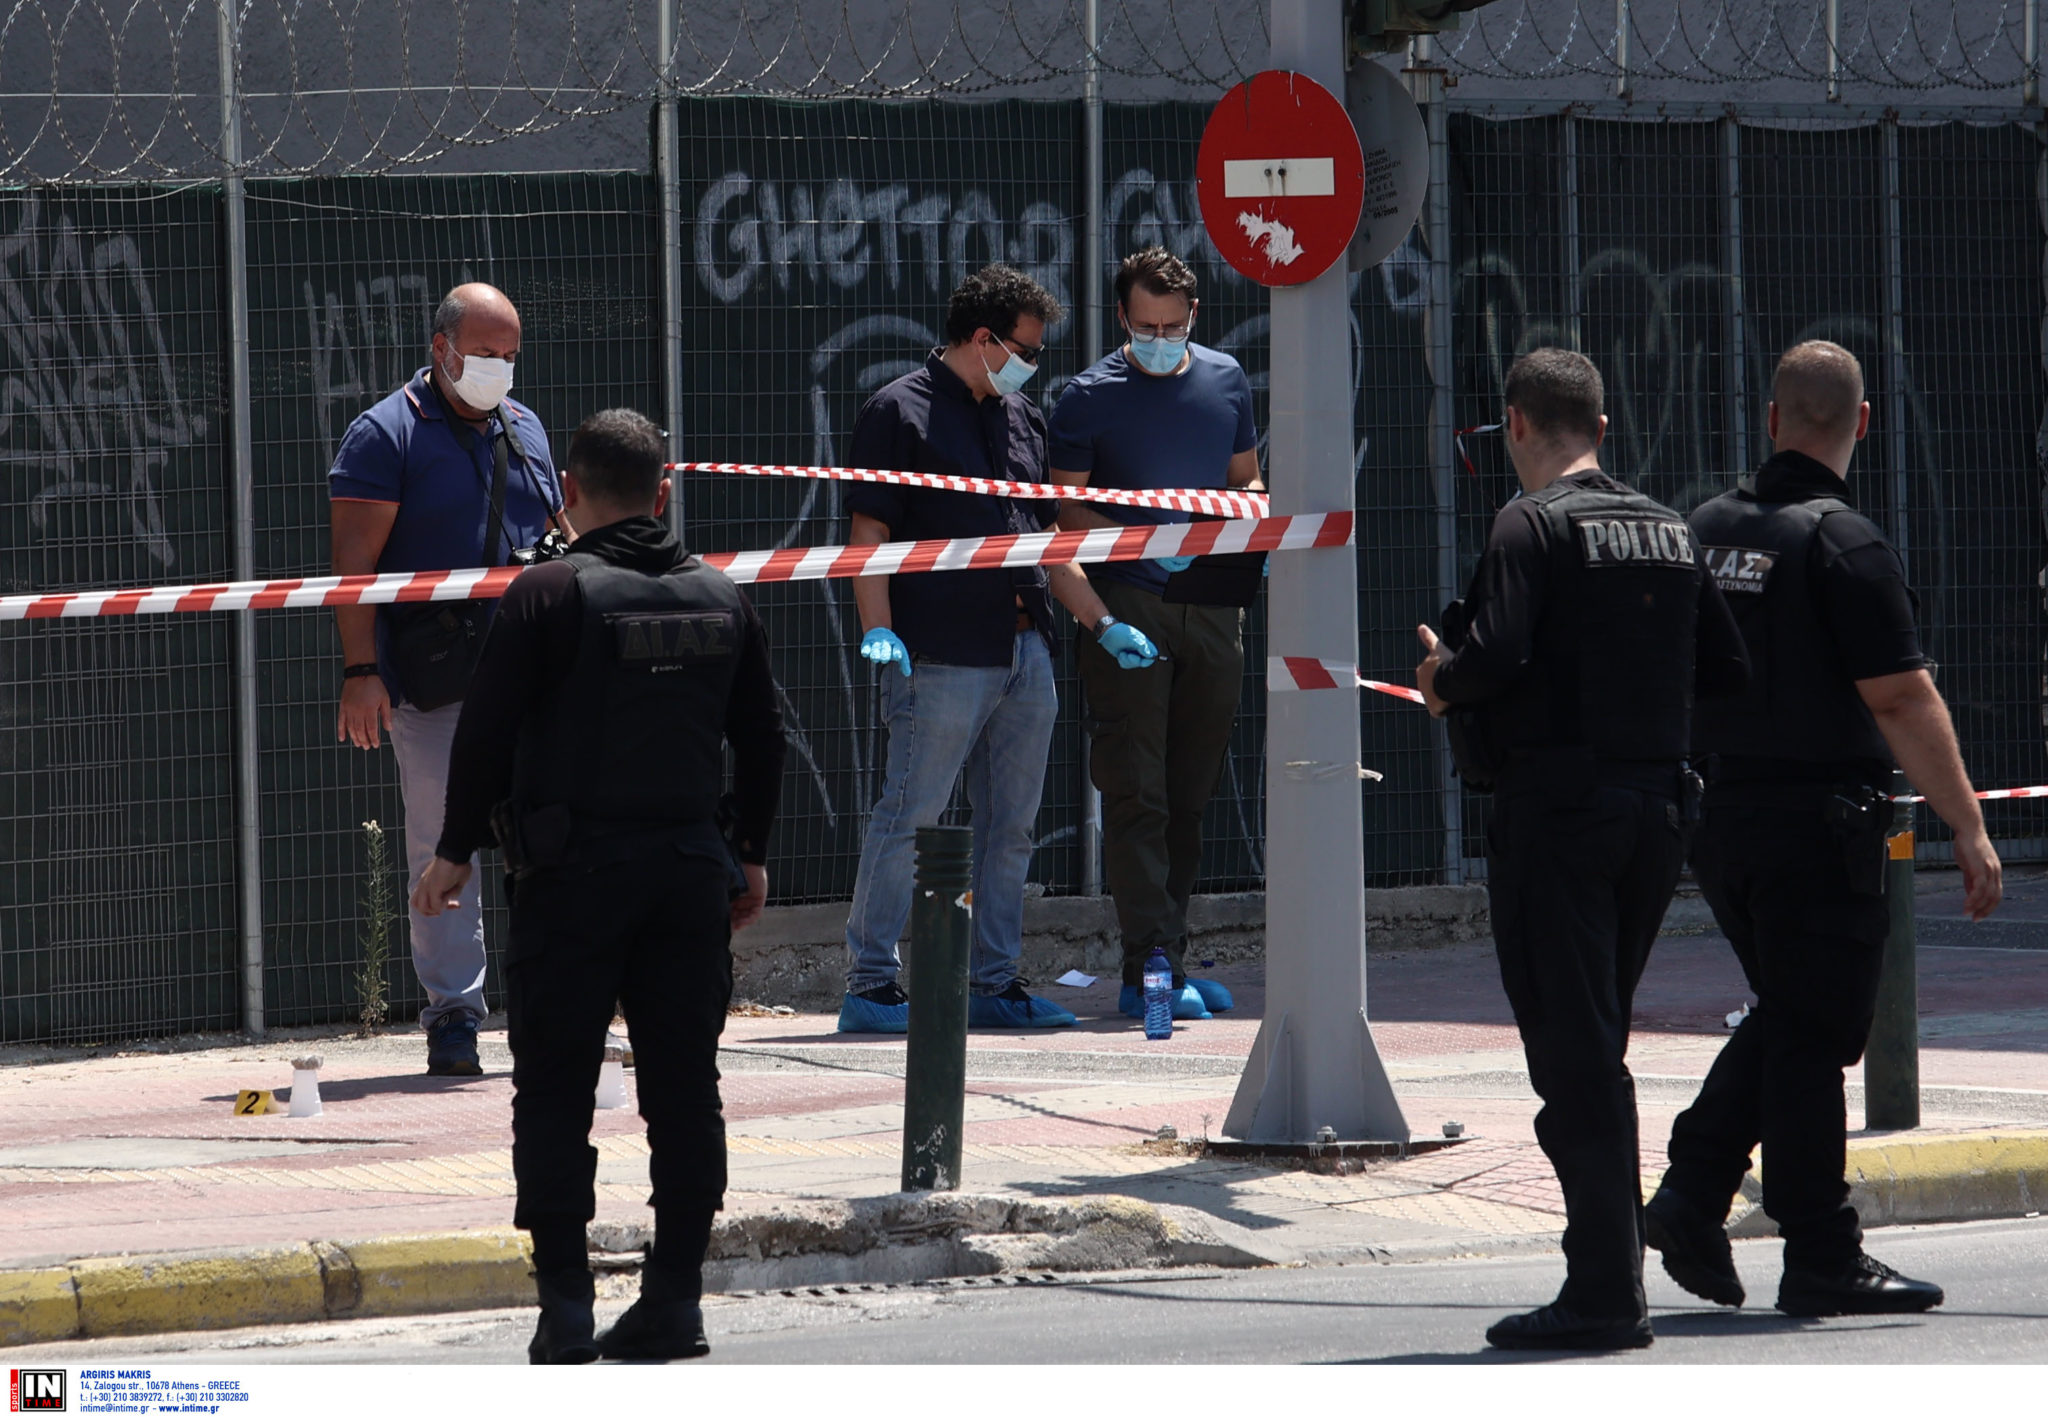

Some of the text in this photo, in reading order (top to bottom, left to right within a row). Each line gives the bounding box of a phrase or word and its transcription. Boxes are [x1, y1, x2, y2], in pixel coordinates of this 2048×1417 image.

[1580, 519, 1695, 564] POLICE
[1705, 549, 1764, 580] Ι.ΑΣ.
[241, 1091, 260, 1115] 2
